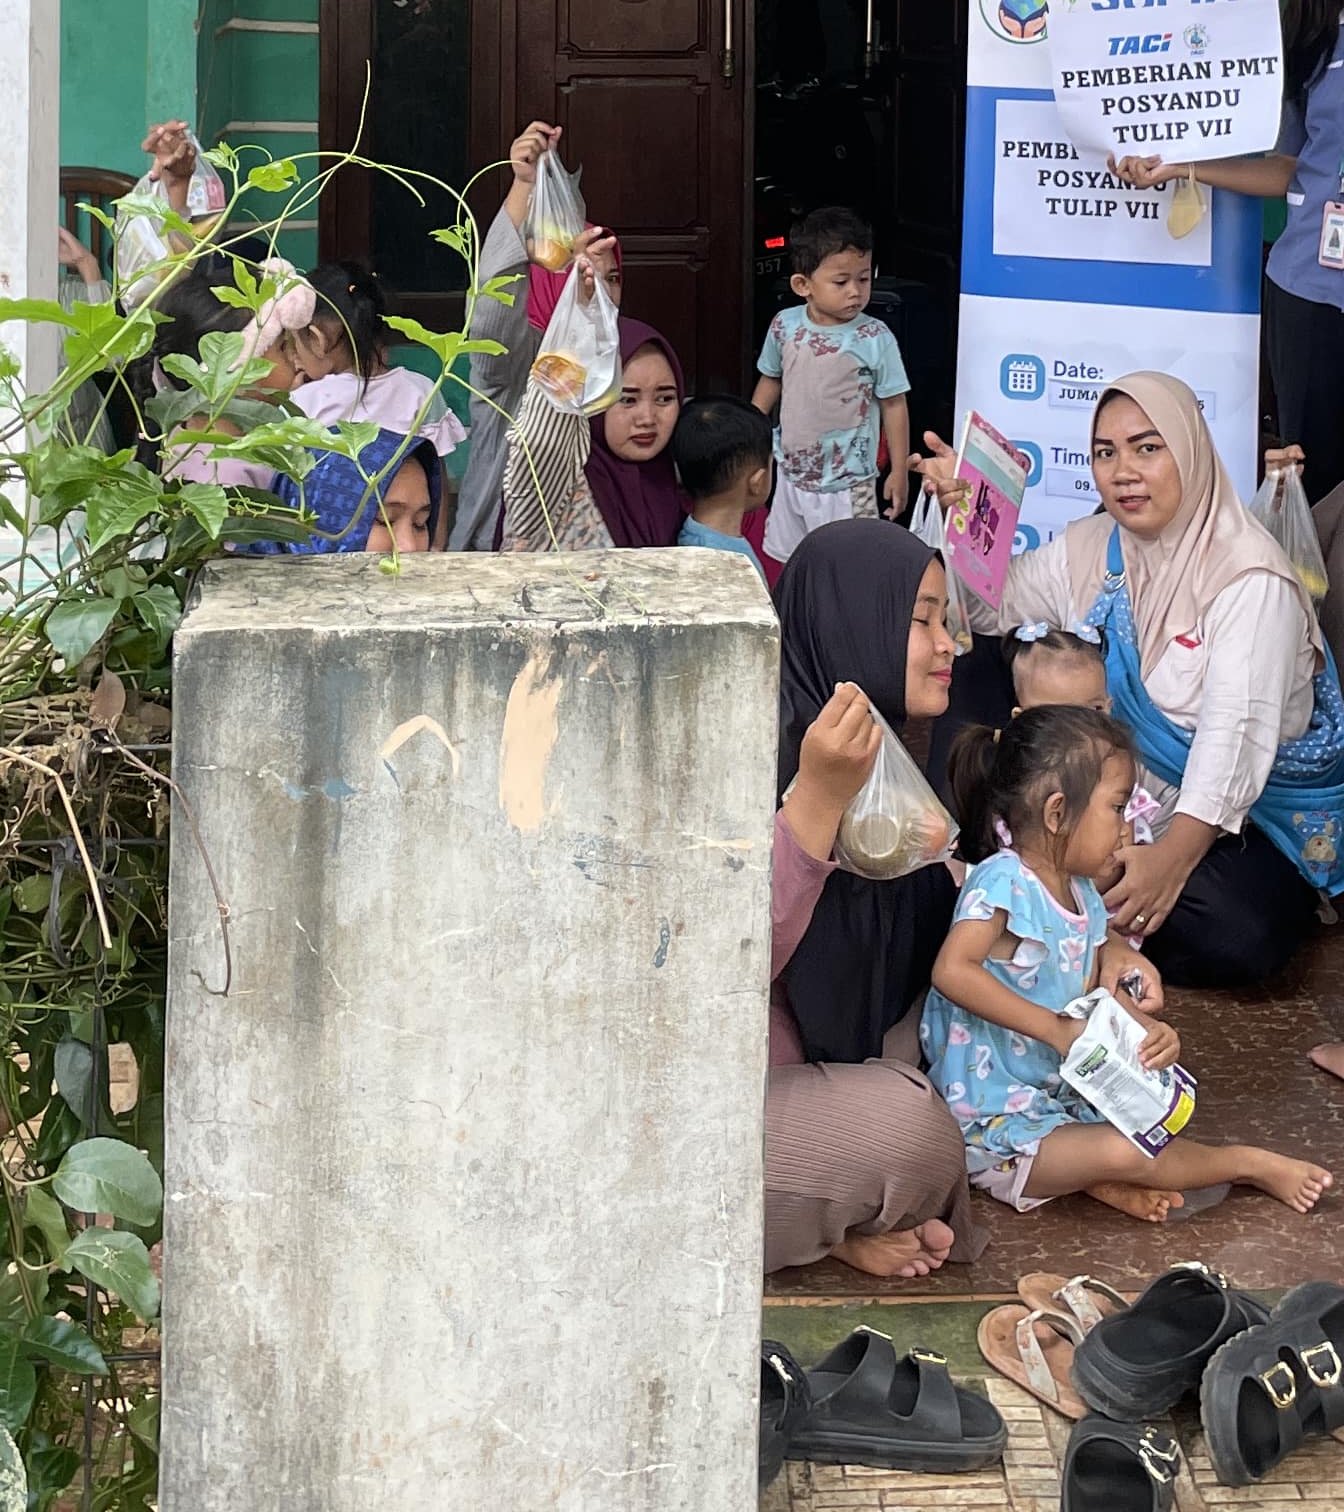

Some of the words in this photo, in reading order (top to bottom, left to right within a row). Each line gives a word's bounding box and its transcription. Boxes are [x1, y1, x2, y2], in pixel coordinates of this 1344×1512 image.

[1061, 60, 1212, 89] PEMBERIAN
[1220, 55, 1279, 78] PMT
[1100, 88, 1241, 116] POSYANDU
[1112, 121, 1189, 144] TULIP
[1196, 117, 1233, 138] VII
[1037, 169, 1167, 192] POSYAN
[1044, 196, 1118, 218] TULIP
[1124, 200, 1159, 220] VII
[1053, 360, 1104, 380] Date:
[1058, 387, 1101, 402] JUMA
